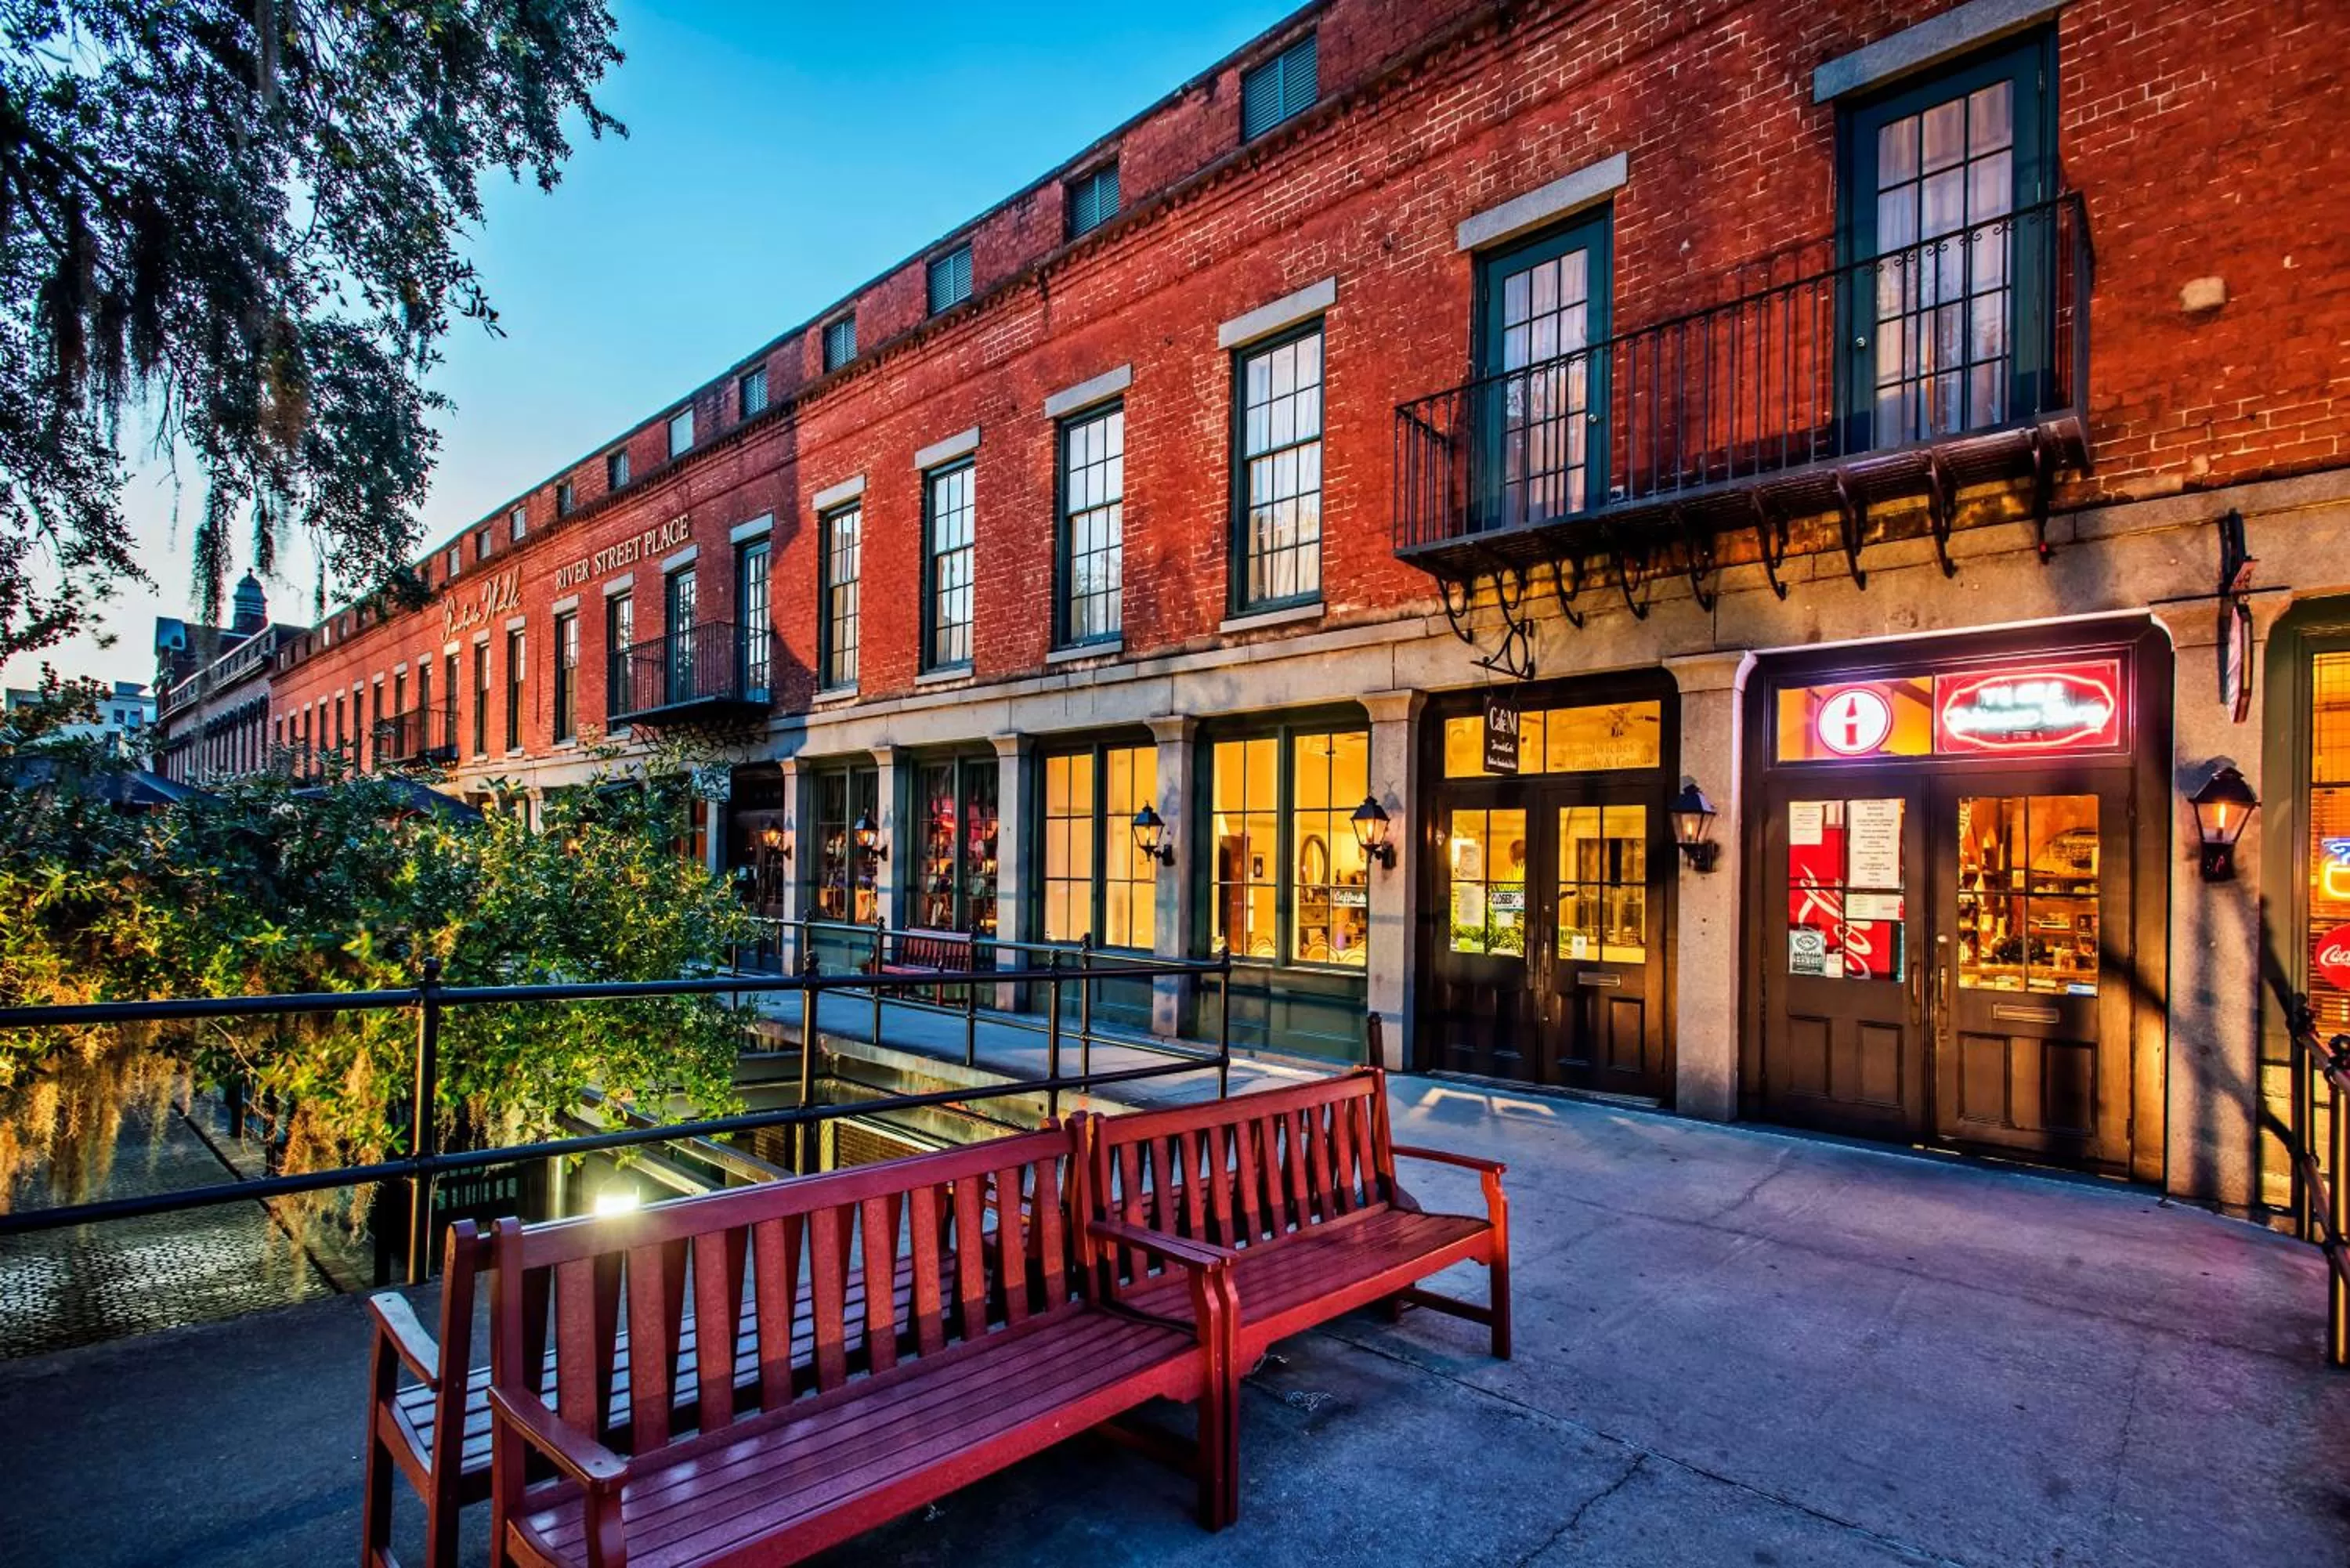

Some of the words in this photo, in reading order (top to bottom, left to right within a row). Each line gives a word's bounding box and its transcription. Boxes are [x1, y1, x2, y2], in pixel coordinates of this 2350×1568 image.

[555, 558, 590, 591] RIVER
[595, 535, 642, 575] STREET
[644, 513, 689, 556] PLACE
